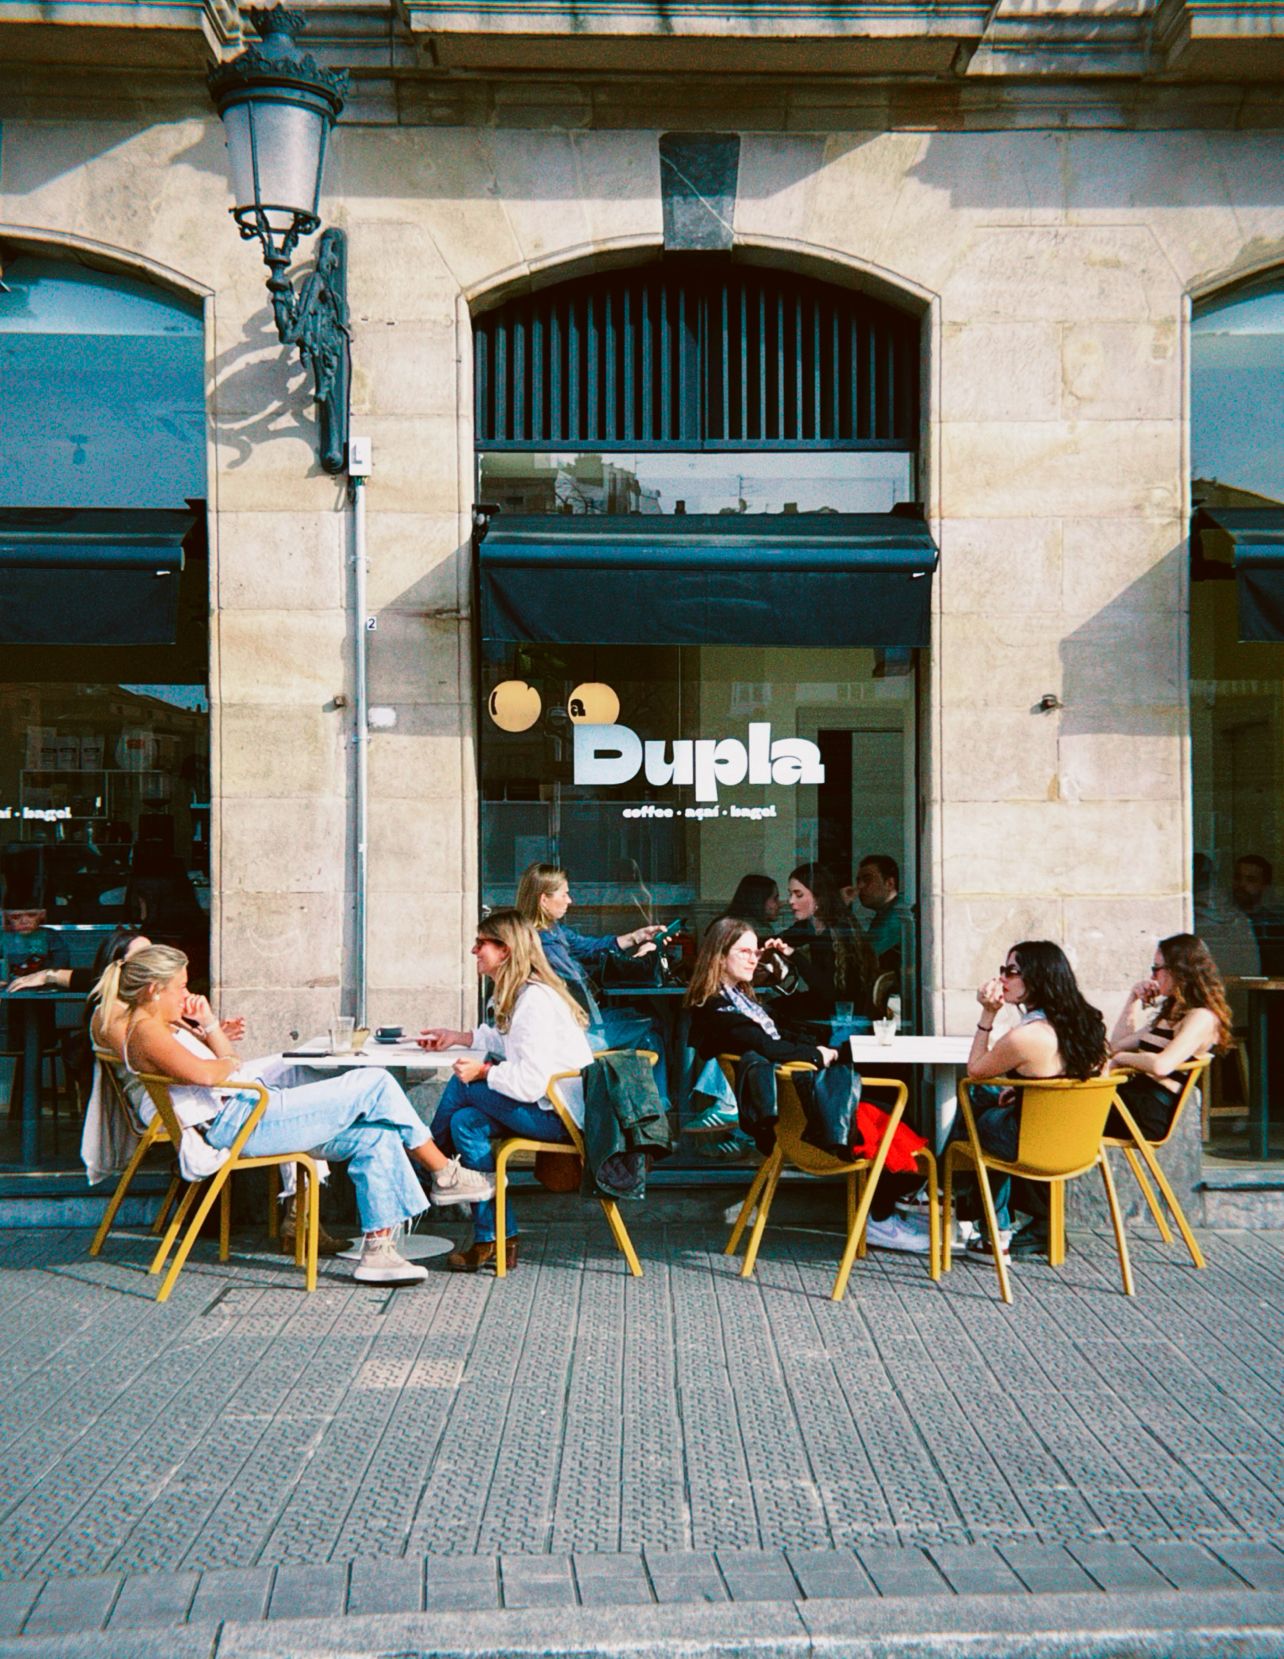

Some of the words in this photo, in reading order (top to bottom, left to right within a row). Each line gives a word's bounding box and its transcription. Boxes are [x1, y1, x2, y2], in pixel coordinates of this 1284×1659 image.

[368, 618, 376, 629] 2
[573, 722, 826, 802] Dupla
[22, 806, 73, 822] bagel
[622, 804, 674, 820] coffee
[730, 804, 778, 822] bagel
